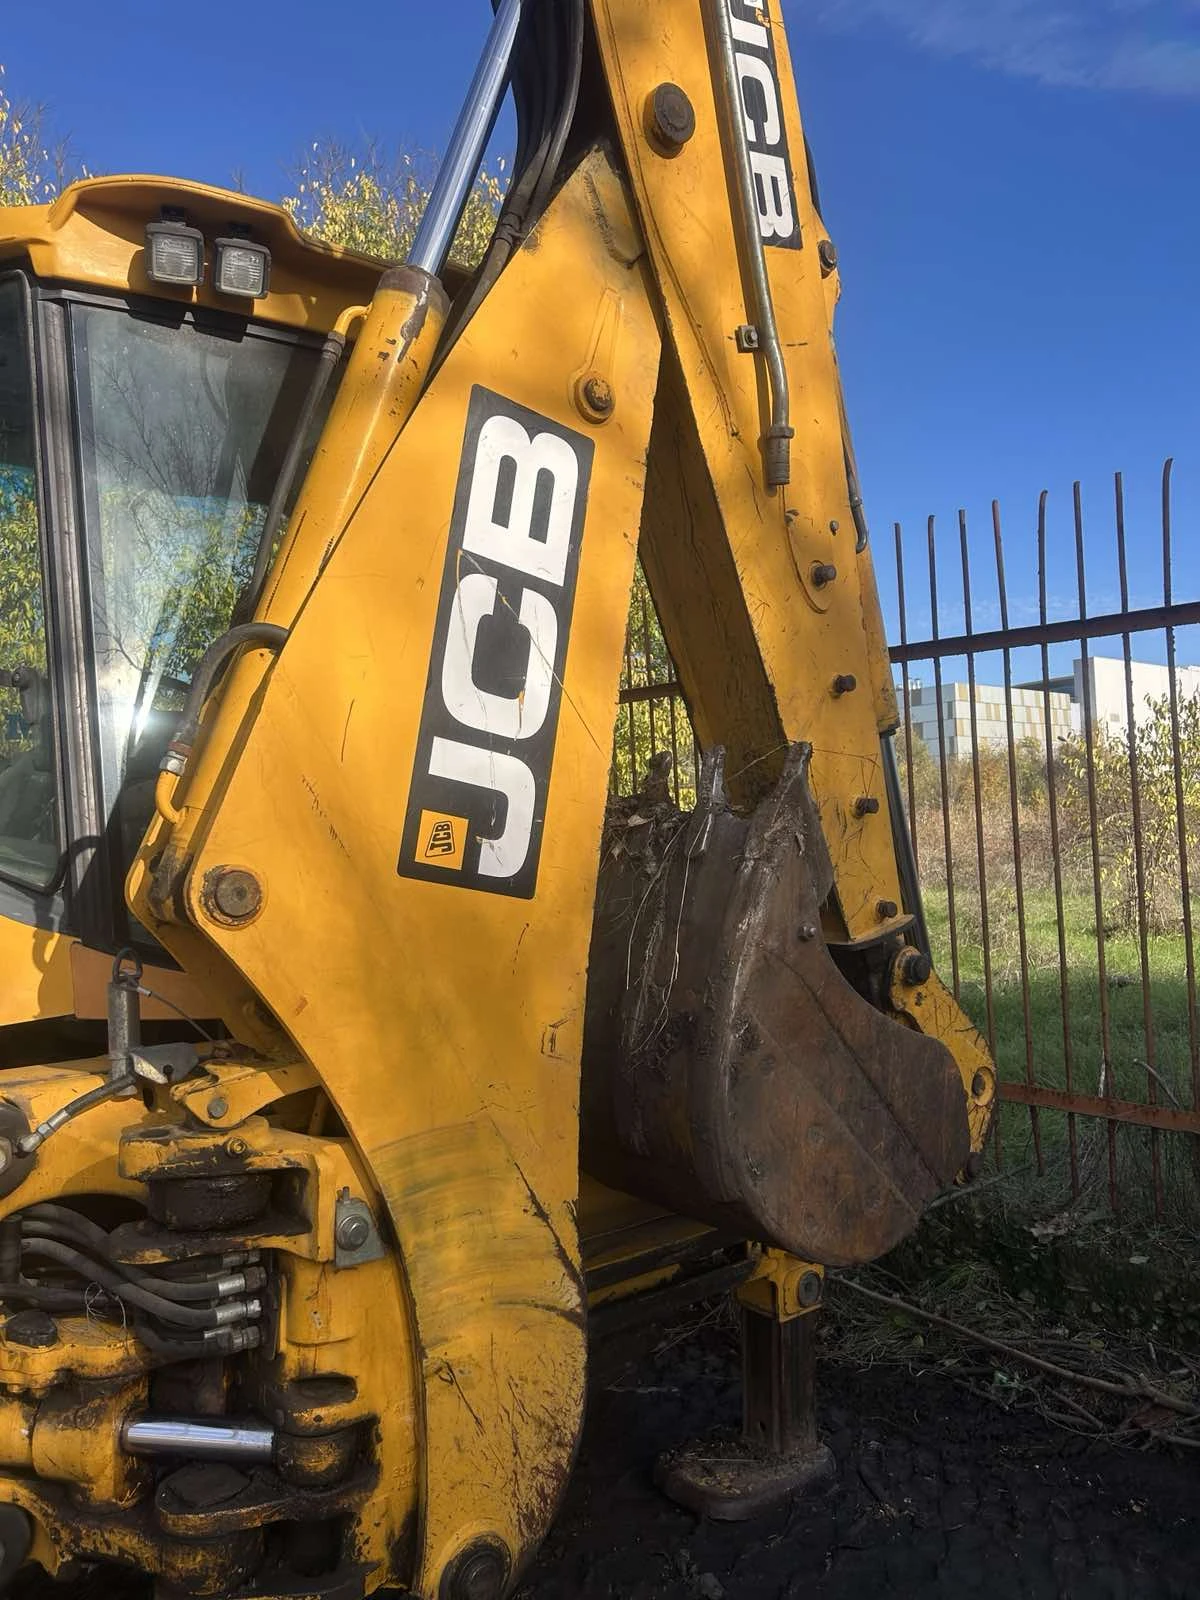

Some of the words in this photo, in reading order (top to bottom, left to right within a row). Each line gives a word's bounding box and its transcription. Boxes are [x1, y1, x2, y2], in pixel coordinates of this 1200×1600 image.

[727, 0, 794, 238] JCB
[428, 415, 579, 878] JCB
[429, 823, 453, 853] JCB
